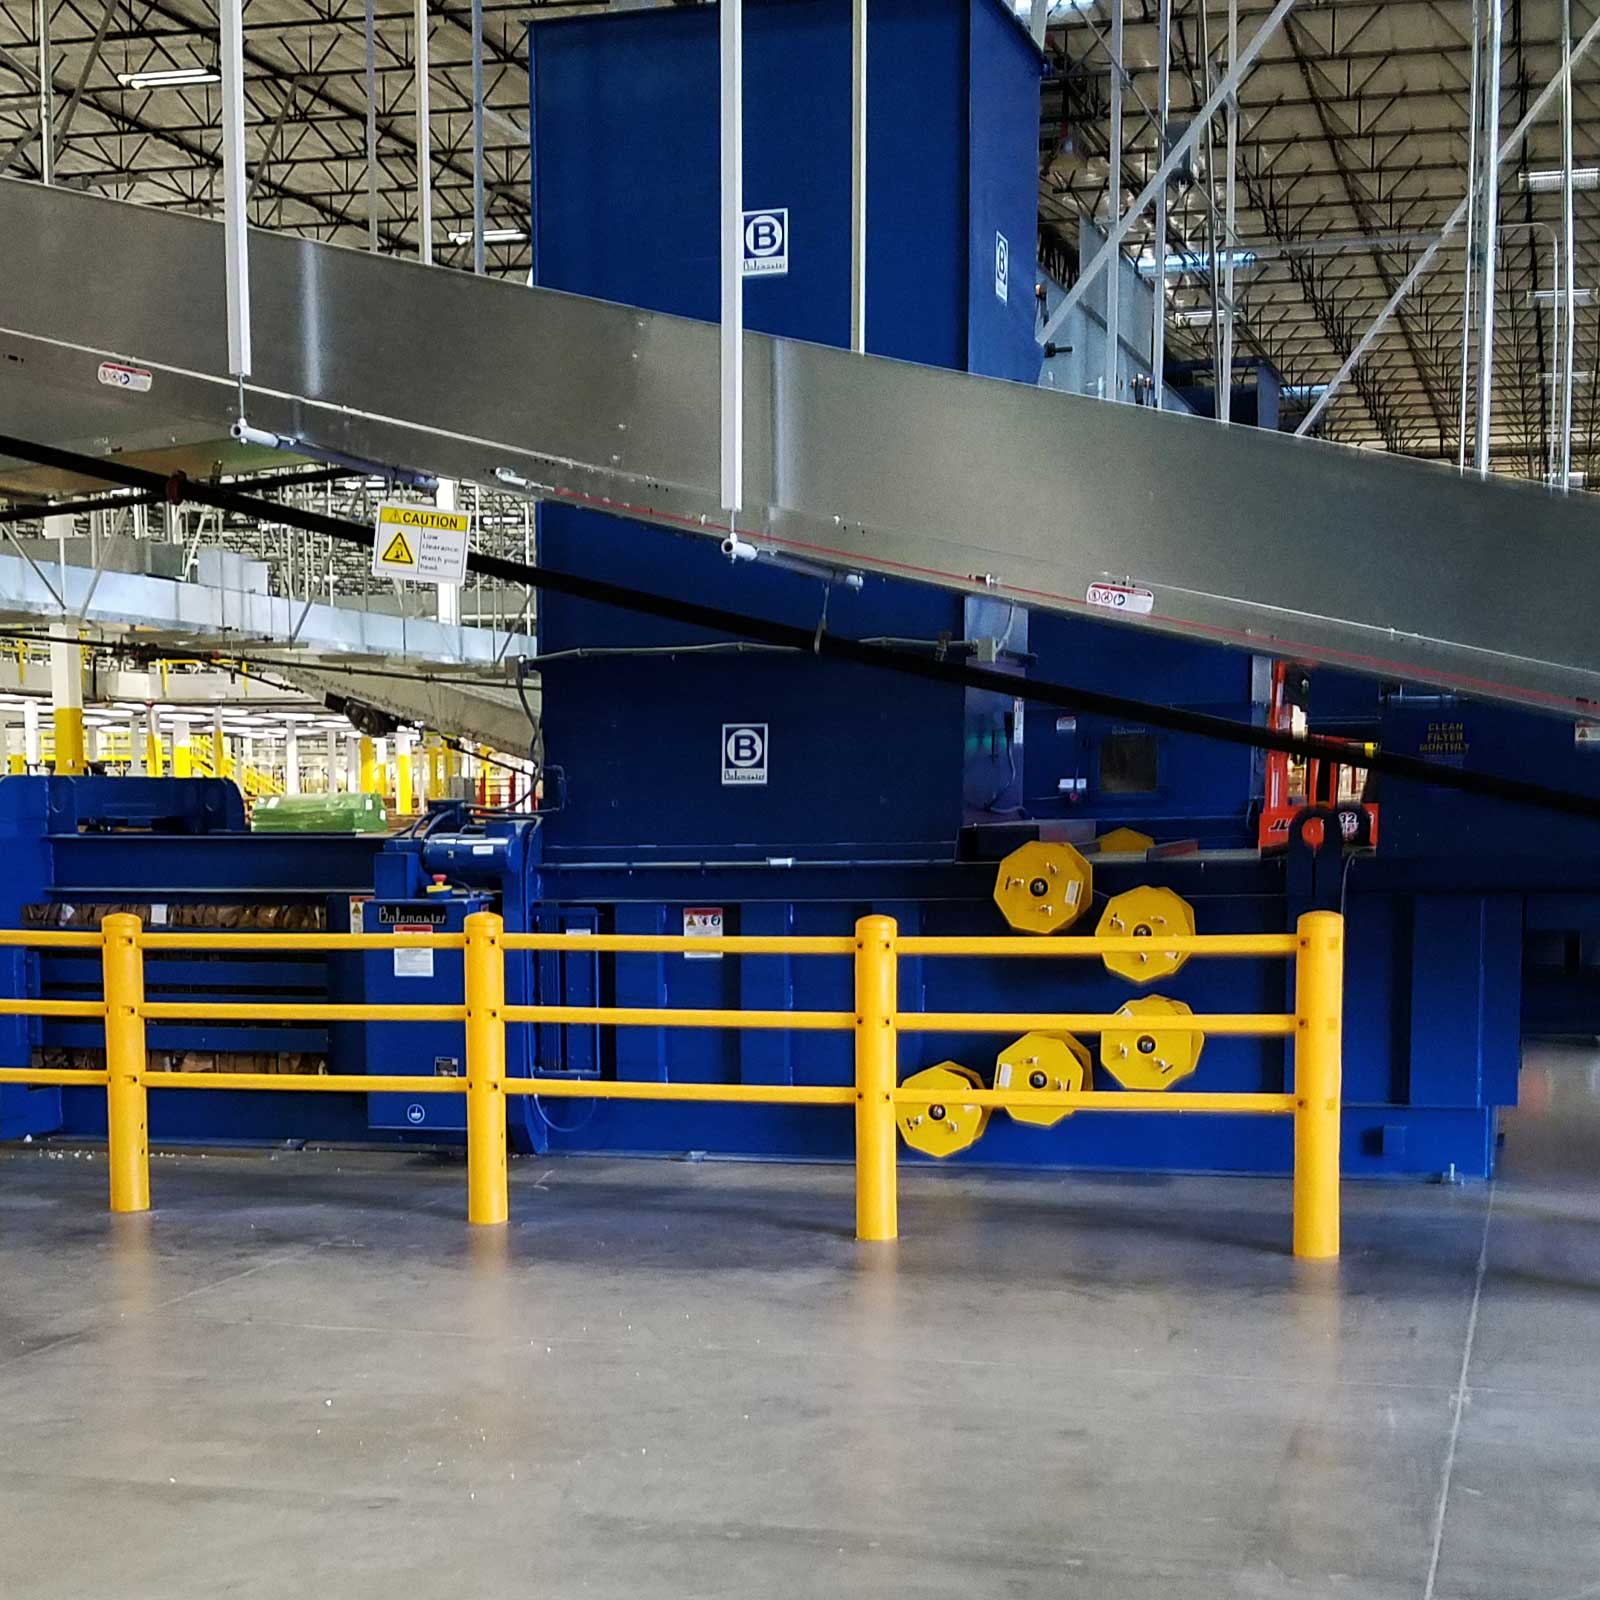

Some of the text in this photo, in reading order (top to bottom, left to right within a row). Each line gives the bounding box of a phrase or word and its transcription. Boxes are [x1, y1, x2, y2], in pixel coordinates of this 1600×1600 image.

[753, 222, 777, 250] B
[999, 245, 1005, 275] B
[402, 511, 459, 529] CAUTION
[423, 532, 438, 540] Low
[421, 555, 442, 563] Watch
[1428, 722, 1463, 731] CLEAN
[1427, 732, 1463, 742] FILTER
[734, 734, 757, 761] B
[1419, 743, 1471, 753] MONTHLY
[1268, 818, 1292, 832] JL
[378, 905, 447, 924] Balemaster
